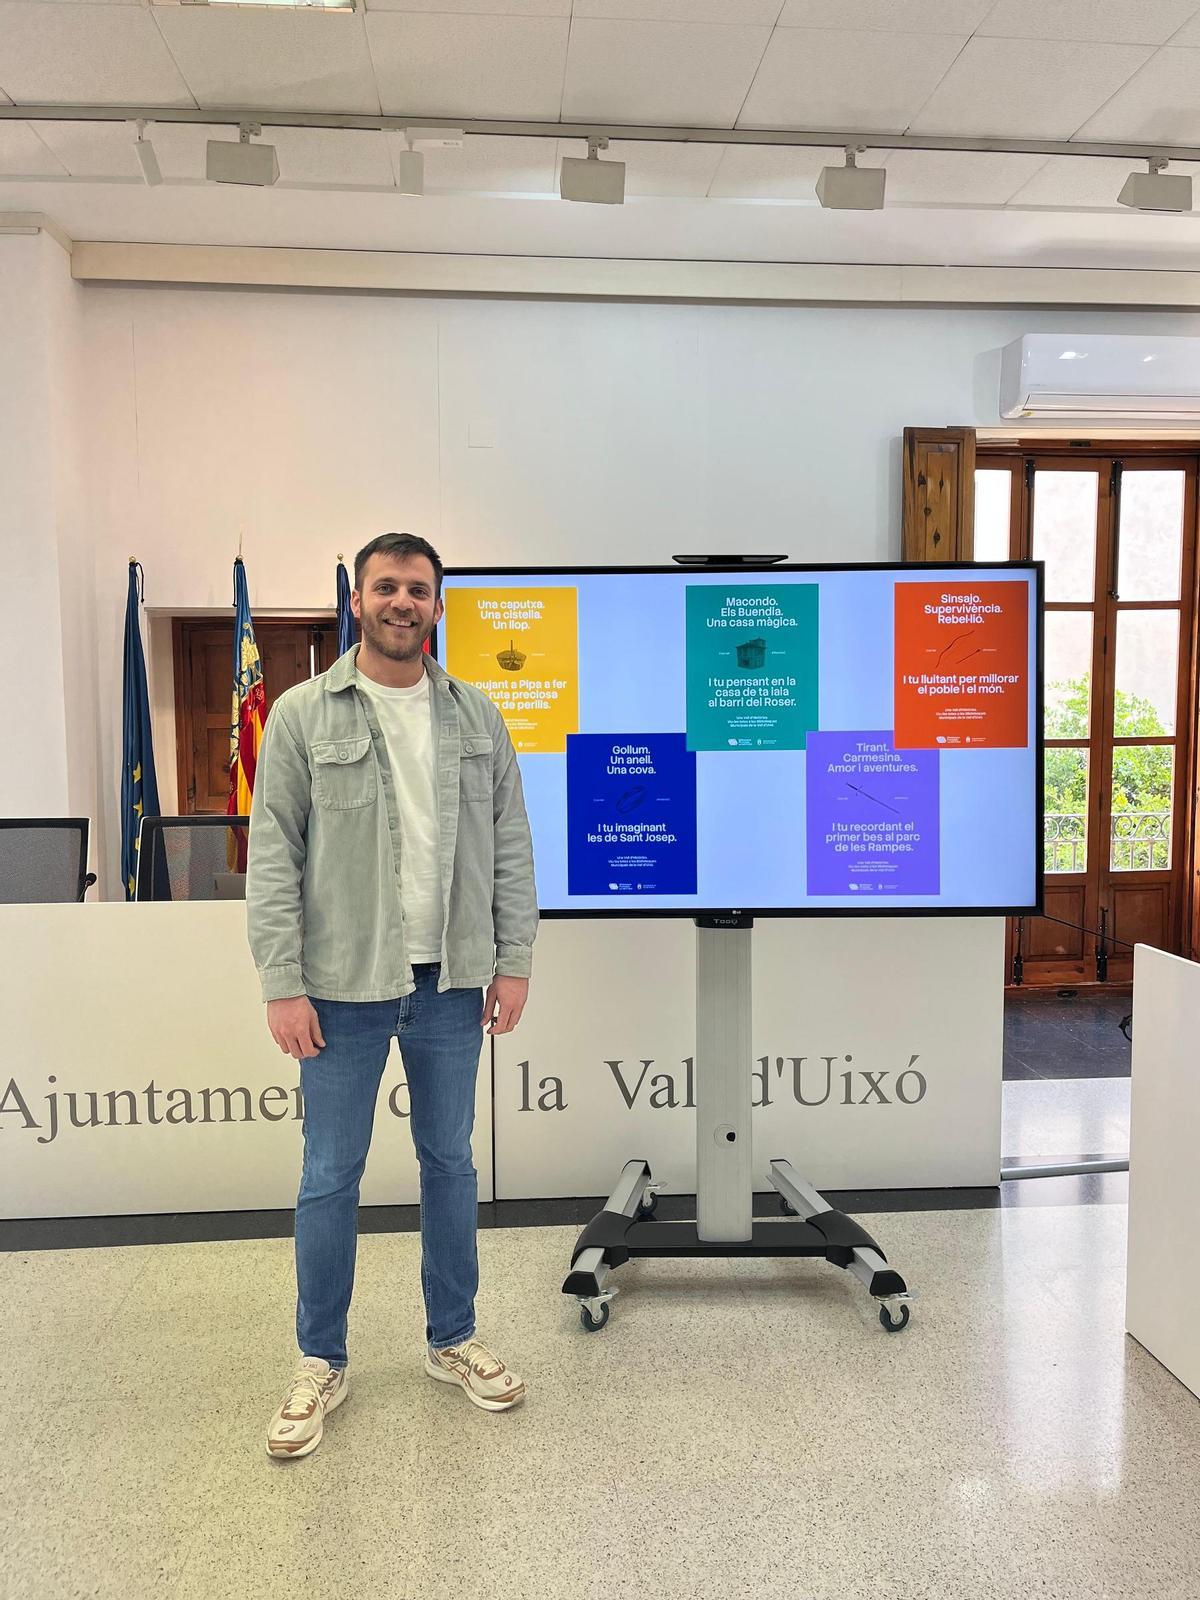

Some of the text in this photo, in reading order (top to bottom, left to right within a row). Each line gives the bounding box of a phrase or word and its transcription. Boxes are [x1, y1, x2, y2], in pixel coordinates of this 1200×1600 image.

[477, 599, 545, 611] Una caputxa.
[726, 597, 778, 606] Macondo.
[941, 594, 982, 605] Sinsajo.
[480, 610, 542, 619] Una cistella.
[721, 608, 736, 616] Els
[924, 604, 1003, 617] Supervivència.
[493, 620, 530, 631] Un llop.
[707, 617, 798, 628] Una casa màgica.
[511, 681, 517, 689] a
[519, 680, 542, 690] Pipa
[553, 679, 567, 688] fer
[714, 678, 724, 687] tu
[726, 677, 769, 688] pensant
[771, 678, 785, 686] en
[787, 676, 796, 686] la
[909, 675, 919, 684] tu
[921, 674, 956, 684] lluitant
[959, 675, 977, 686] per
[979, 674, 1019, 683] millorar
[489, 690, 558, 701] ruta preciosa
[715, 688, 741, 697] casa
[742, 687, 756, 696] de
[759, 687, 769, 696] ta
[918, 685, 928, 694] el
[930, 685, 959, 696] poble
[967, 684, 976, 694] el
[978, 684, 1004, 694] món.
[502, 700, 515, 709] de
[517, 700, 551, 711] perills.
[709, 697, 796, 707] al barri del Roser.
[613, 745, 651, 755] Gollum.
[856, 743, 890, 752] Tirant.
[610, 755, 653, 764] Un anell.
[843, 753, 902, 762] Carmesina.
[607, 765, 656, 775] Una cova.
[827, 764, 856, 773] Amor
[863, 763, 918, 772] aventures.
[603, 824, 613, 832] tu
[615, 823, 666, 834] imaginant
[837, 823, 847, 832] tu
[850, 822, 902, 832] recordant
[905, 822, 914, 831] el
[604, 833, 617, 842] de
[620, 833, 643, 842] Sant
[645, 833, 677, 844] Josep.
[826, 832, 920, 844] primer bes al parc
[835, 843, 914, 853] de les Rampes.
[0, 1075, 304, 1144] Ajuntame
[516, 1060, 568, 1112] la
[603, 1056, 696, 1110] Val
